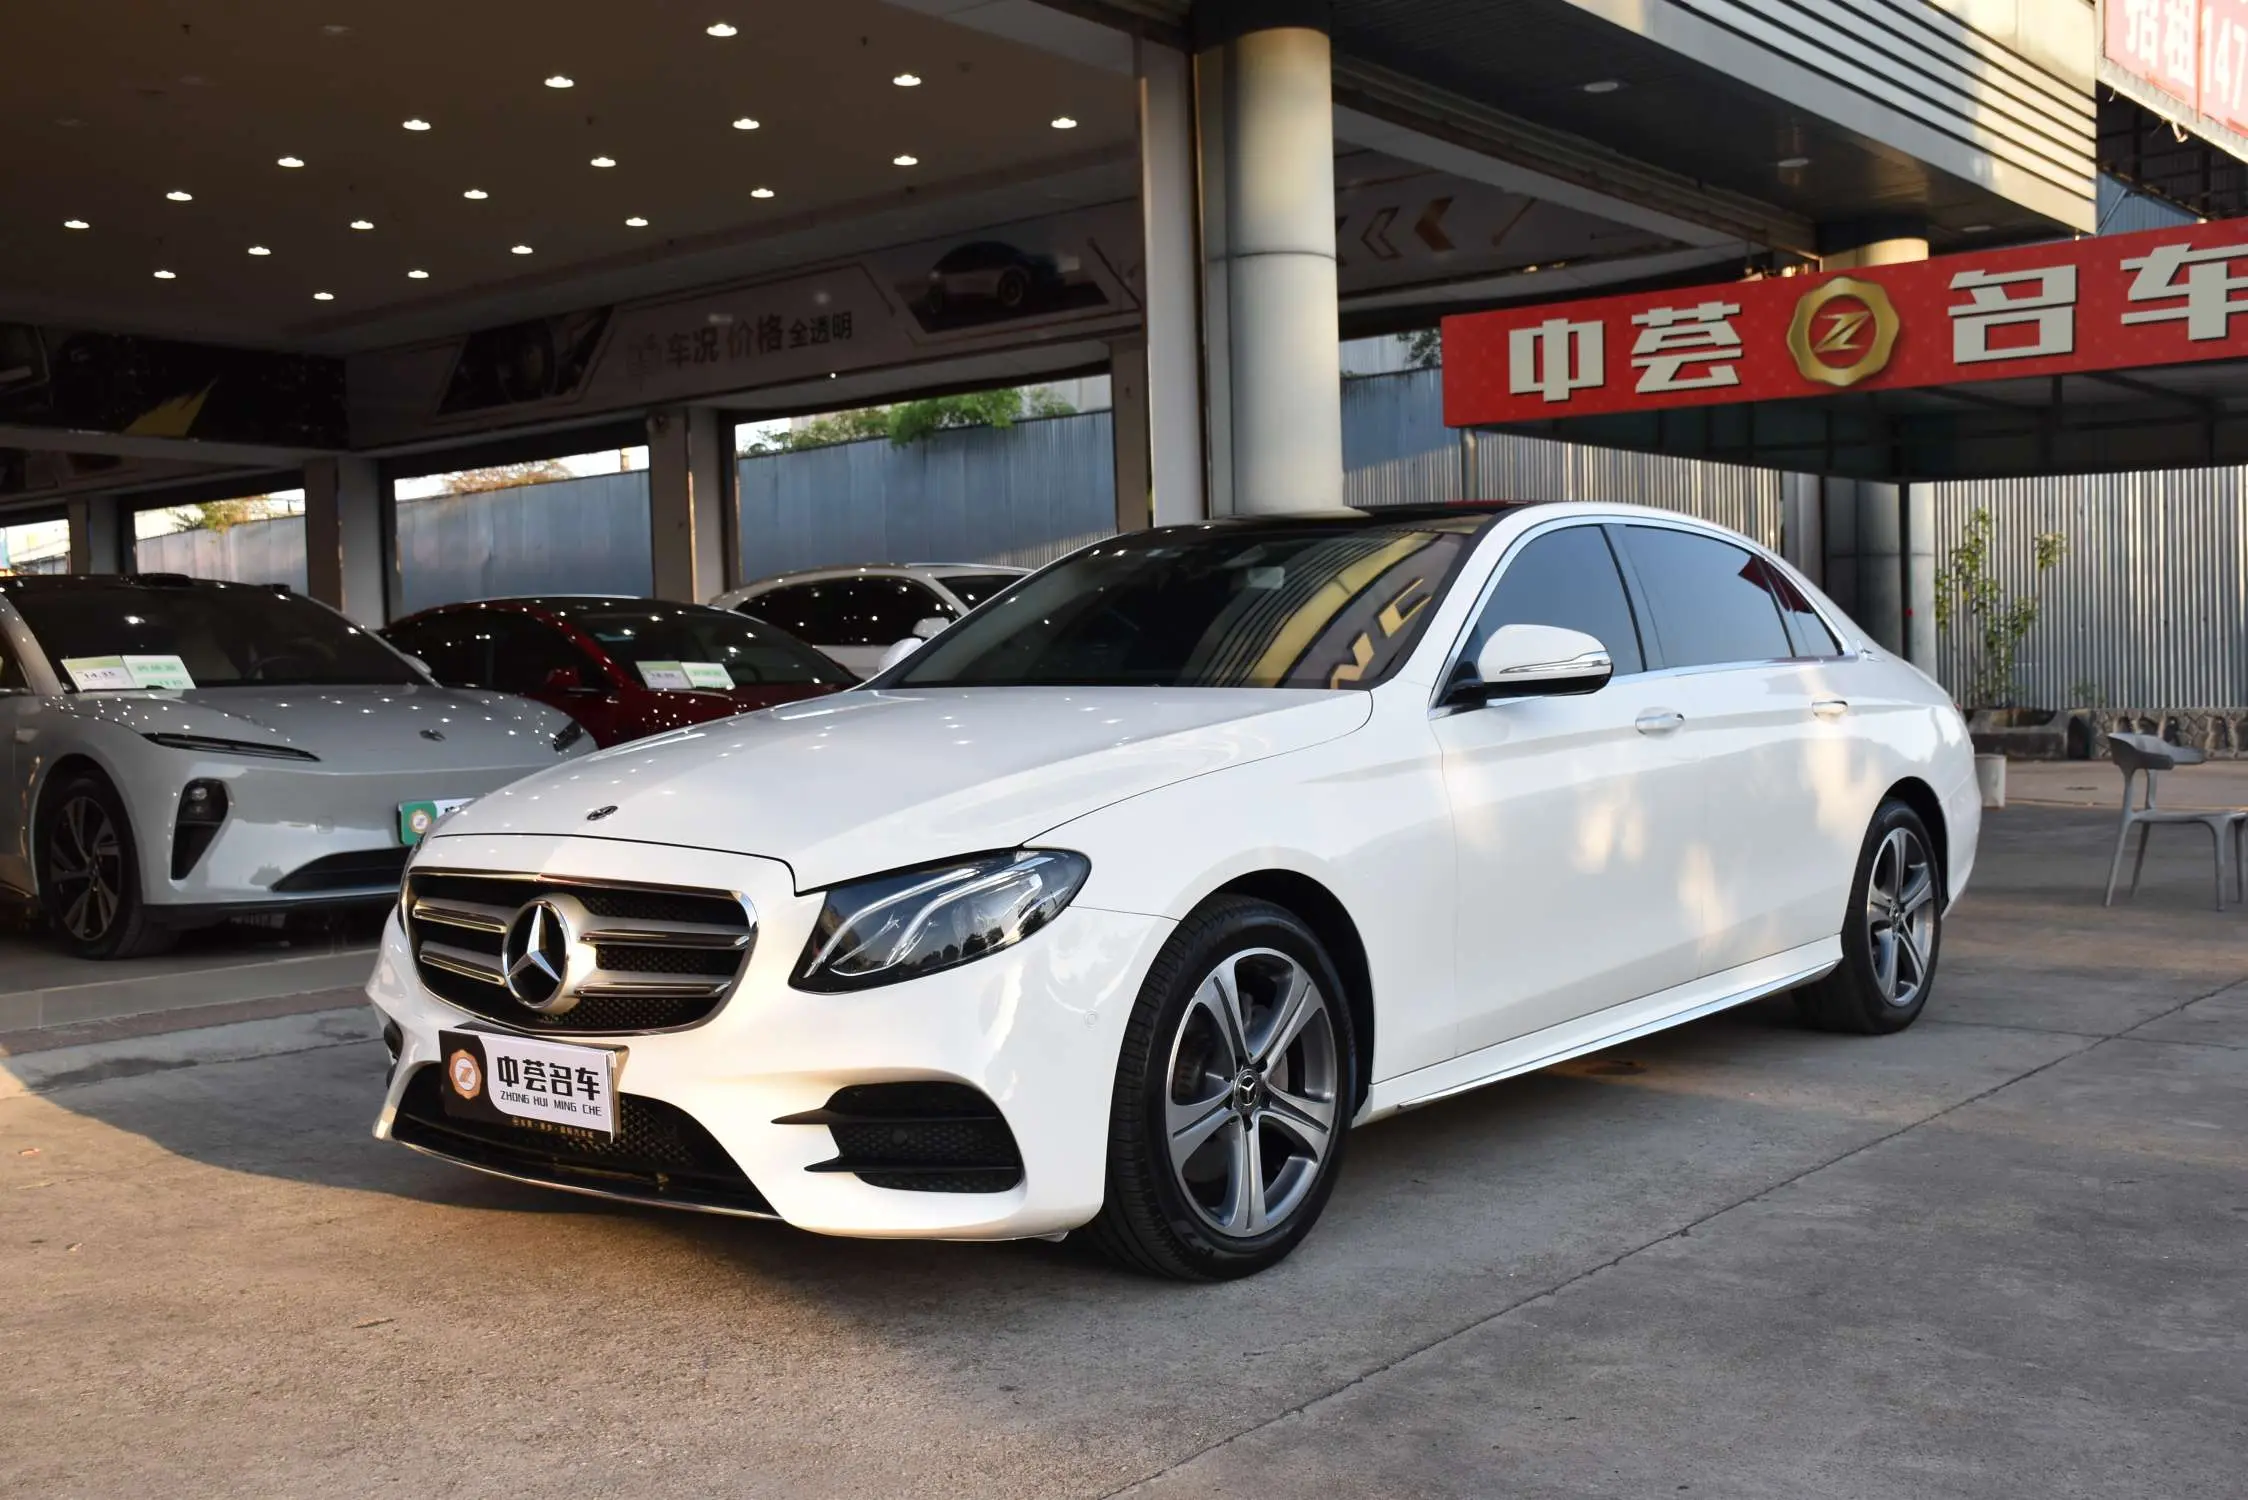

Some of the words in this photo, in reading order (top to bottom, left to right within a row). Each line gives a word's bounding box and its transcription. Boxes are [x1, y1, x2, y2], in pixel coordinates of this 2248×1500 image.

[1508, 301, 1743, 402] 中荟
[1947, 242, 2248, 364] 名车
[496, 1056, 601, 1101] 中荟名车
[500, 1090, 530, 1105] ZHONG
[533, 1096, 549, 1107] HUI
[554, 1100, 577, 1112] MING
[582, 1104, 603, 1116] CHE
